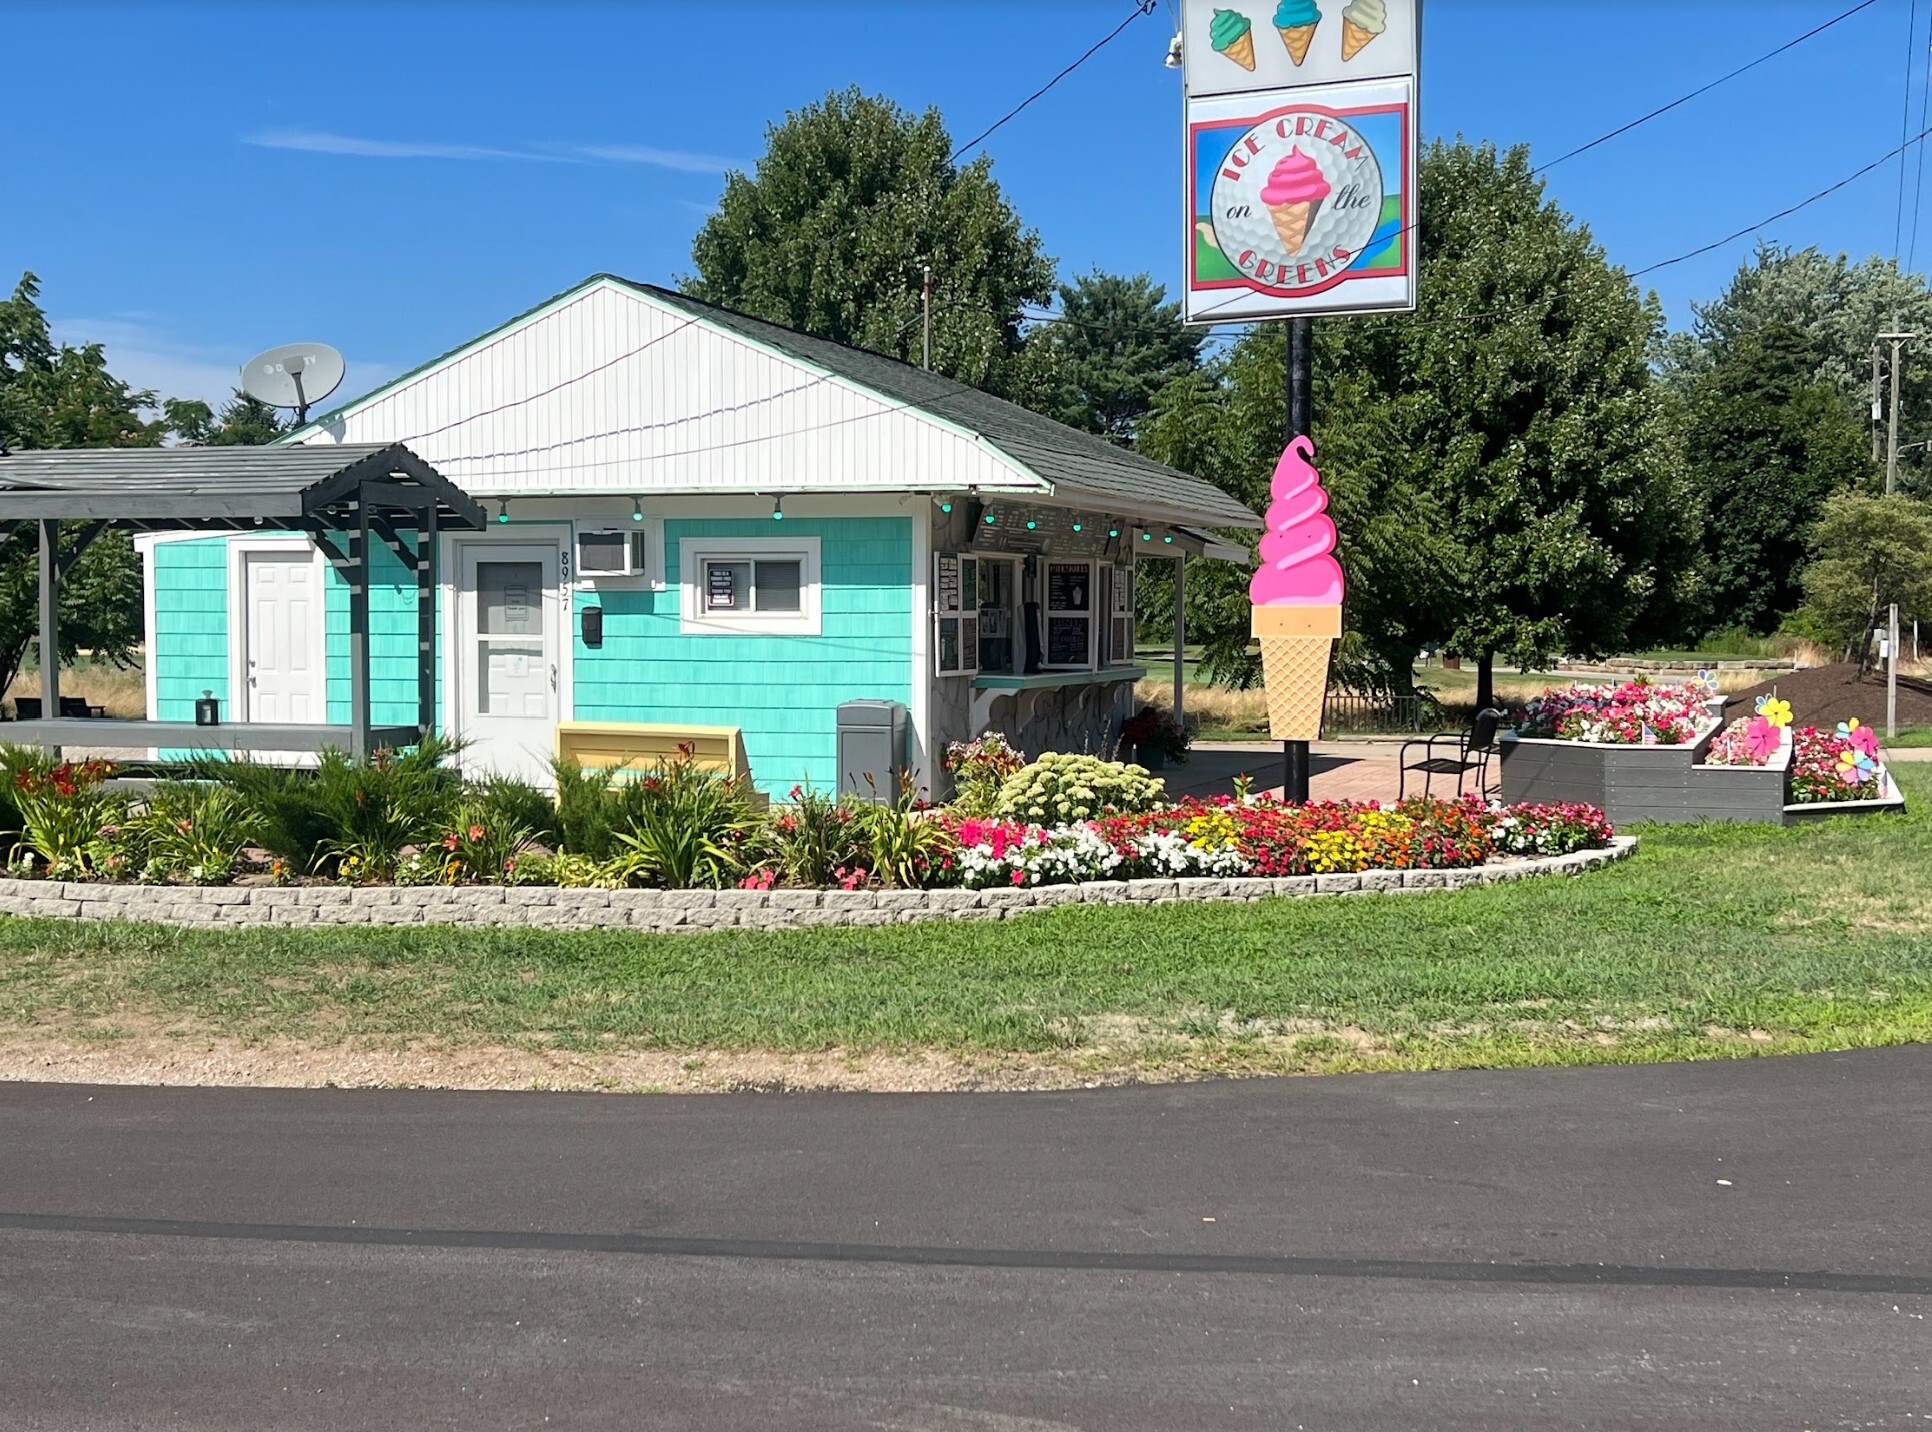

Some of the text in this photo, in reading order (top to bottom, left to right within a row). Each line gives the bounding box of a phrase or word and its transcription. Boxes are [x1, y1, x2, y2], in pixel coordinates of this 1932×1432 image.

[1222, 116, 1369, 182] ICE CREAM
[1226, 182, 1372, 220] on the
[1238, 244, 1351, 285] GREENS
[561, 551, 569, 611] 8957
